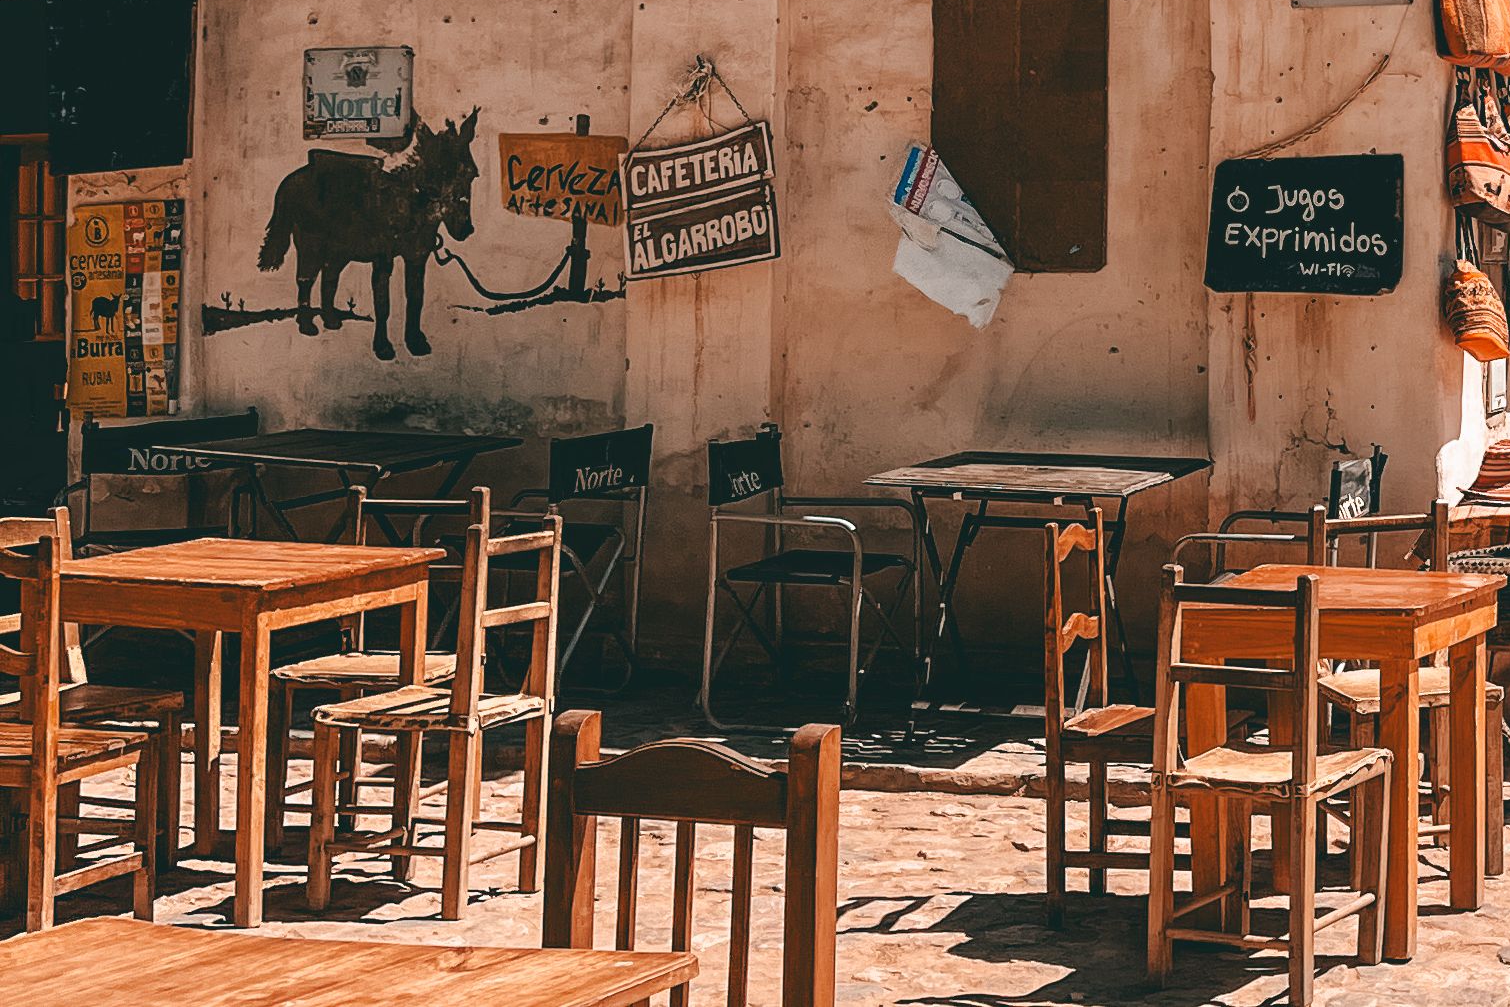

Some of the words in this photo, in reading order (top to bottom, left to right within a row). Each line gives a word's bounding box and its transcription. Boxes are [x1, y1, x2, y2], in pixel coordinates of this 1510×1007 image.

[314, 91, 396, 119] Norte
[1265, 184, 1345, 221] Jugos
[632, 205, 768, 272] ALGARROBO
[633, 222, 651, 241] EL
[1224, 221, 1388, 259] Exprimidos
[70, 253, 121, 270] cerveza
[1299, 262, 1341, 277] WI-FI
[77, 338, 123, 358] Burra
[82, 370, 112, 386] RUBIA
[574, 465, 622, 493] Norte
